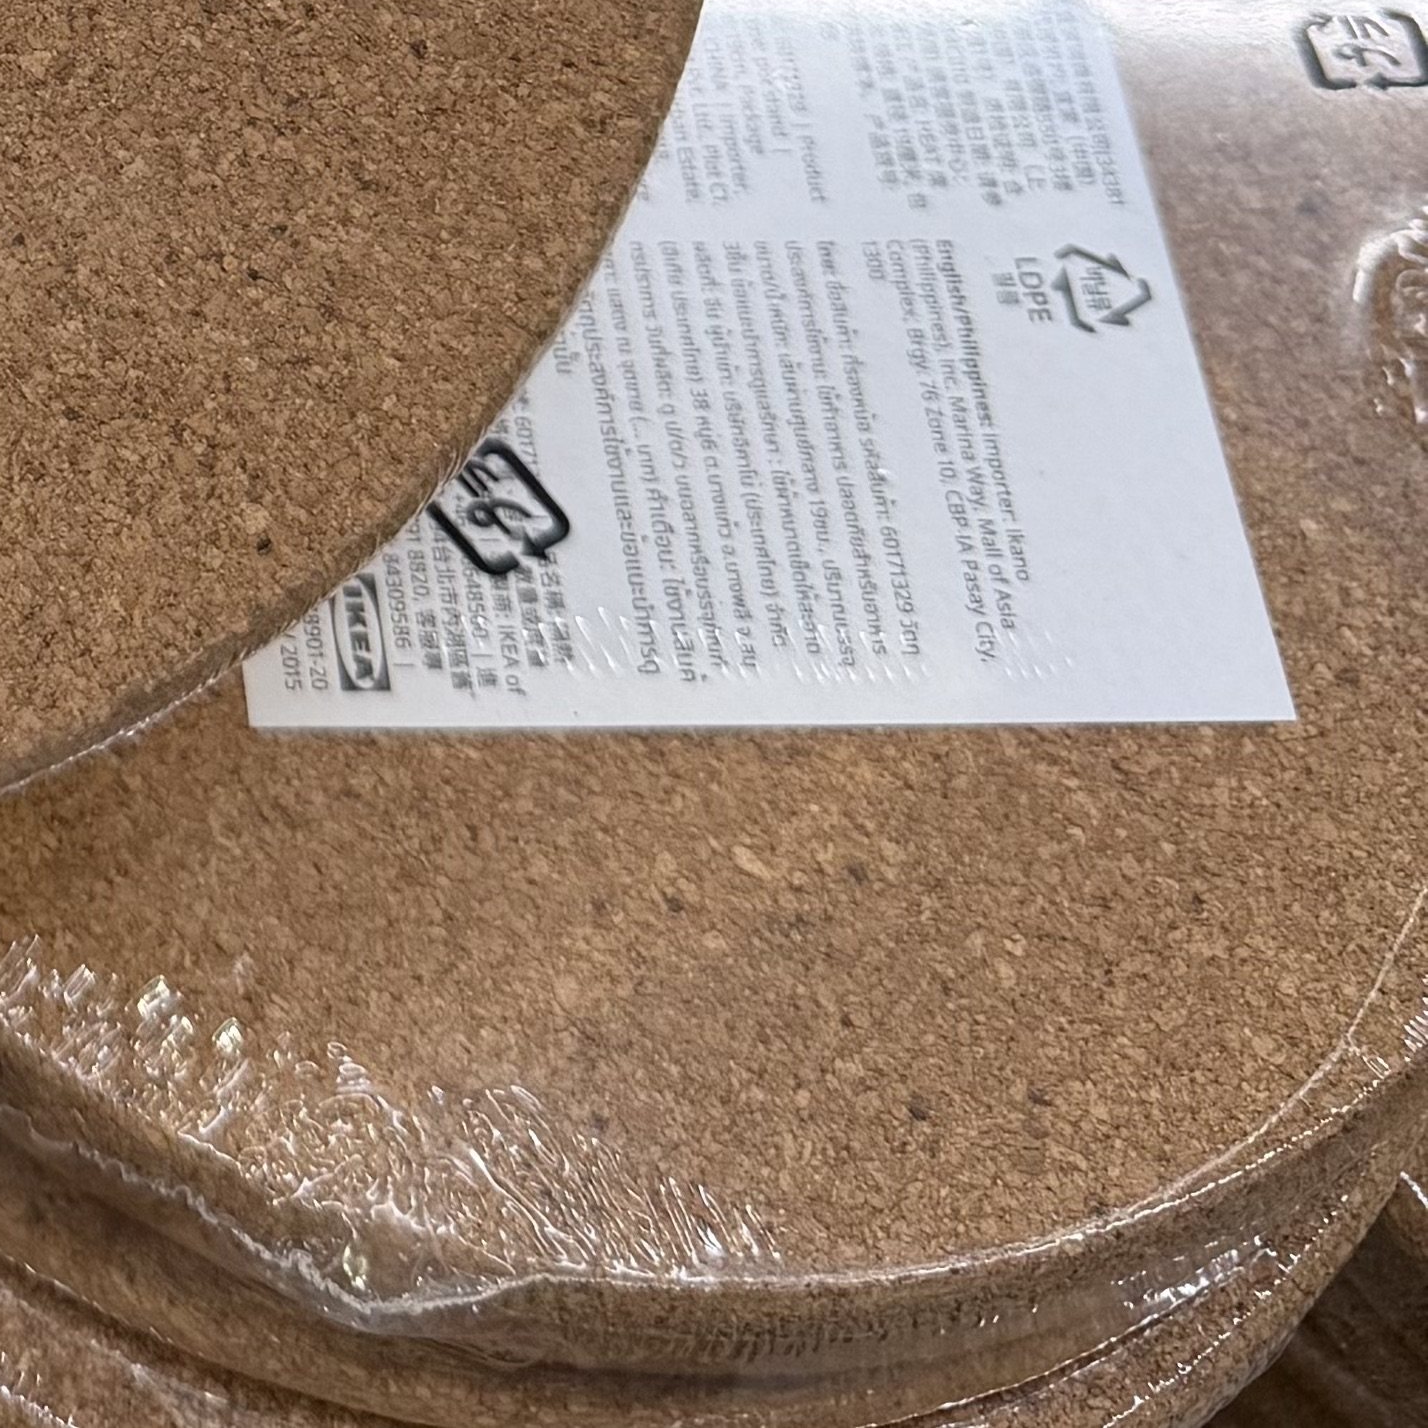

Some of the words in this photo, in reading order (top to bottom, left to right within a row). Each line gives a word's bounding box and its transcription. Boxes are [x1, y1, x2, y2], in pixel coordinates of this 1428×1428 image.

[862, 240, 886, 281] 1300
[1014, 256, 1053, 322] LDPE
[689, 388, 712, 411] 38
[918, 380, 940, 402] 76
[936, 239, 993, 427] English/Philippines:
[982, 432, 1016, 522] Importer:
[1005, 528, 1030, 582] Ikano
[924, 406, 948, 453] Zone
[948, 395, 976, 462] Marina
[977, 517, 1003, 558] Mall
[879, 525, 915, 614] 60171329
[960, 558, 986, 616] Pasay
[987, 563, 1010, 585] of
[380, 551, 412, 649] 84309586
[993, 588, 1017, 630] Asia
[341, 585, 374, 680] IKEA
[497, 625, 520, 666] IKEA
[974, 620, 997, 663] City,
[504, 673, 527, 697] of
